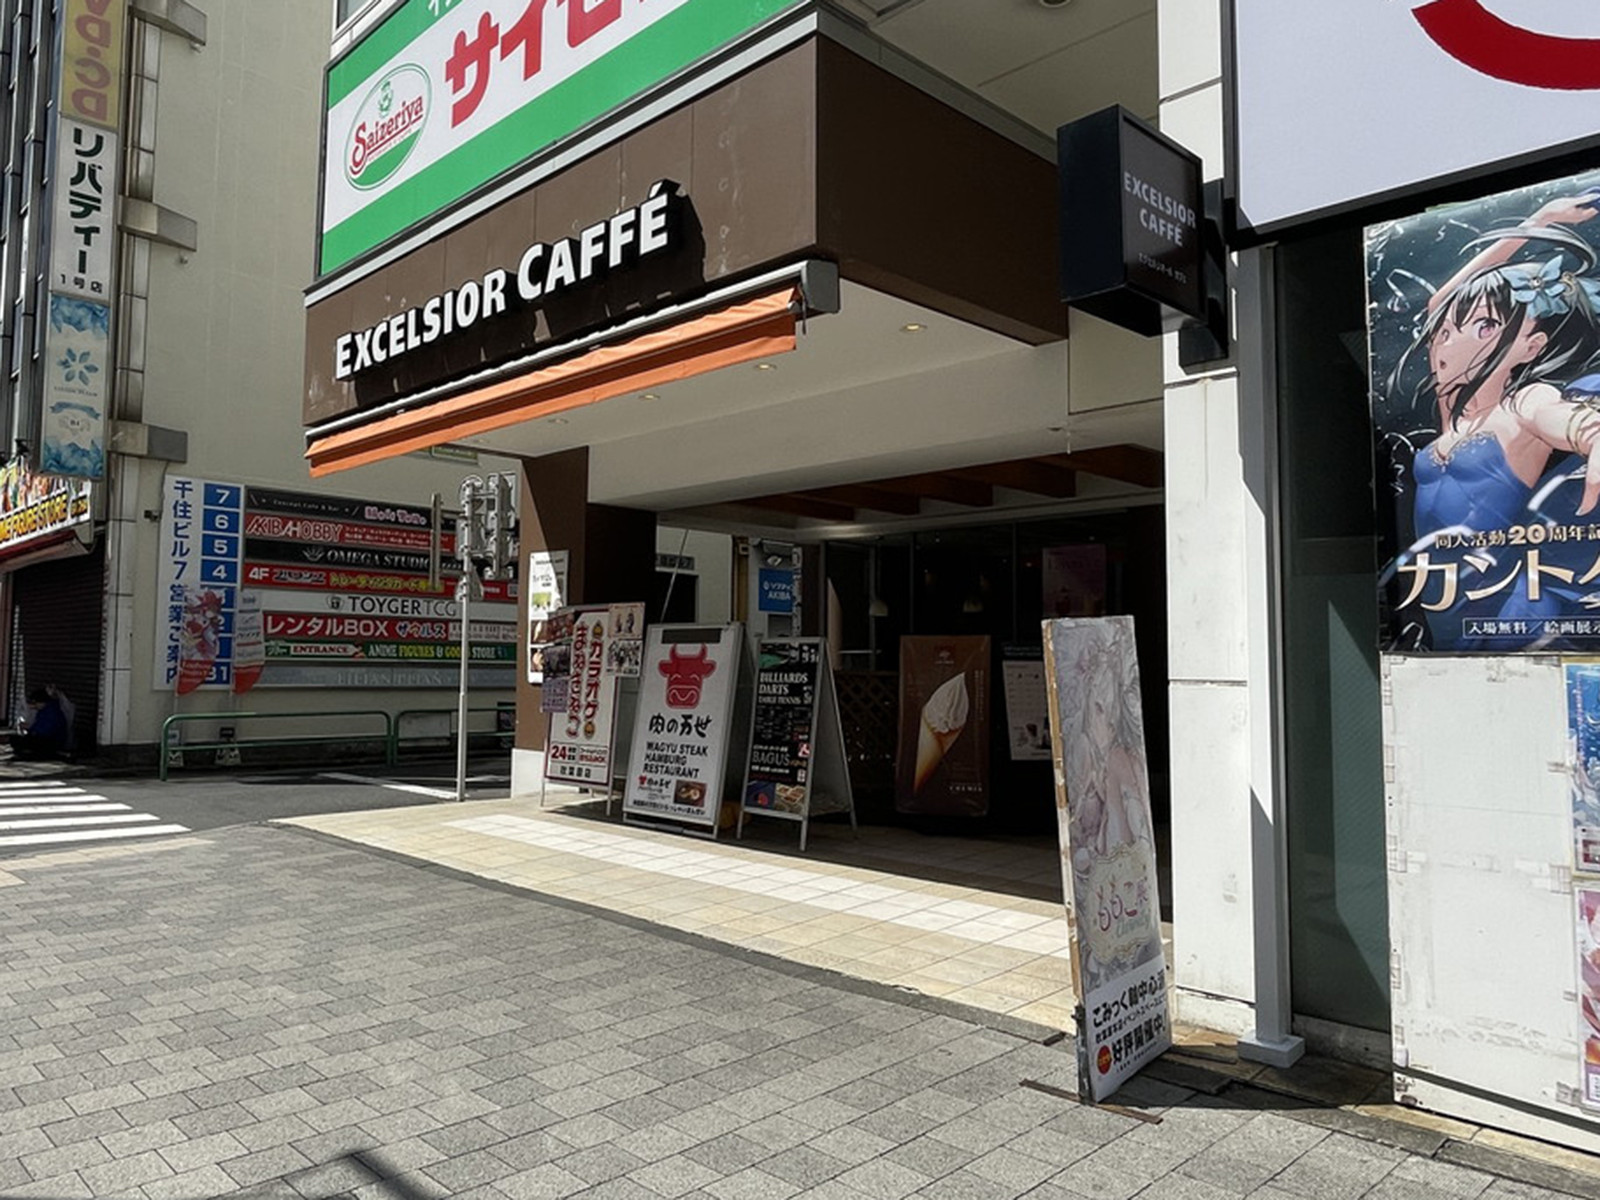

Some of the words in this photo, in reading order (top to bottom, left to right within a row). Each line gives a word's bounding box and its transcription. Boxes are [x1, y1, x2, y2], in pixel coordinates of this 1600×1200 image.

[350, 95, 423, 175] Saizeriya
[70, 127, 104, 275] リバティー
[1124, 172, 1196, 229] EXCELSIOR
[1140, 208, 1183, 247] CAFFÉ
[60, 274, 103, 295] 1号店
[335, 269, 506, 380] EXCELSIOR
[516, 182, 669, 302] CAFFÉ
[216, 489, 231, 504] 7
[214, 515, 229, 530] 6
[213, 540, 229, 554] 5
[326, 549, 381, 566] OMEGA
[212, 565, 227, 580] 4
[249, 568, 270, 580] 4F
[267, 615, 388, 637] レンタルBOX
[293, 645, 350, 656] ENTRANCE
[368, 644, 398, 657] ANIME
[399, 645, 435, 658] FIGURES
[760, 671, 808, 684] BILLIARDS
[759, 683, 789, 696] DARTS
[551, 745, 567, 761] 24
[646, 742, 678, 755] WAGYU
[679, 744, 709, 758] STEAK
[644, 753, 688, 767] HAMBURG
[752, 751, 790, 767] BAGUS
[642, 763, 700, 779] RESTAURANT
